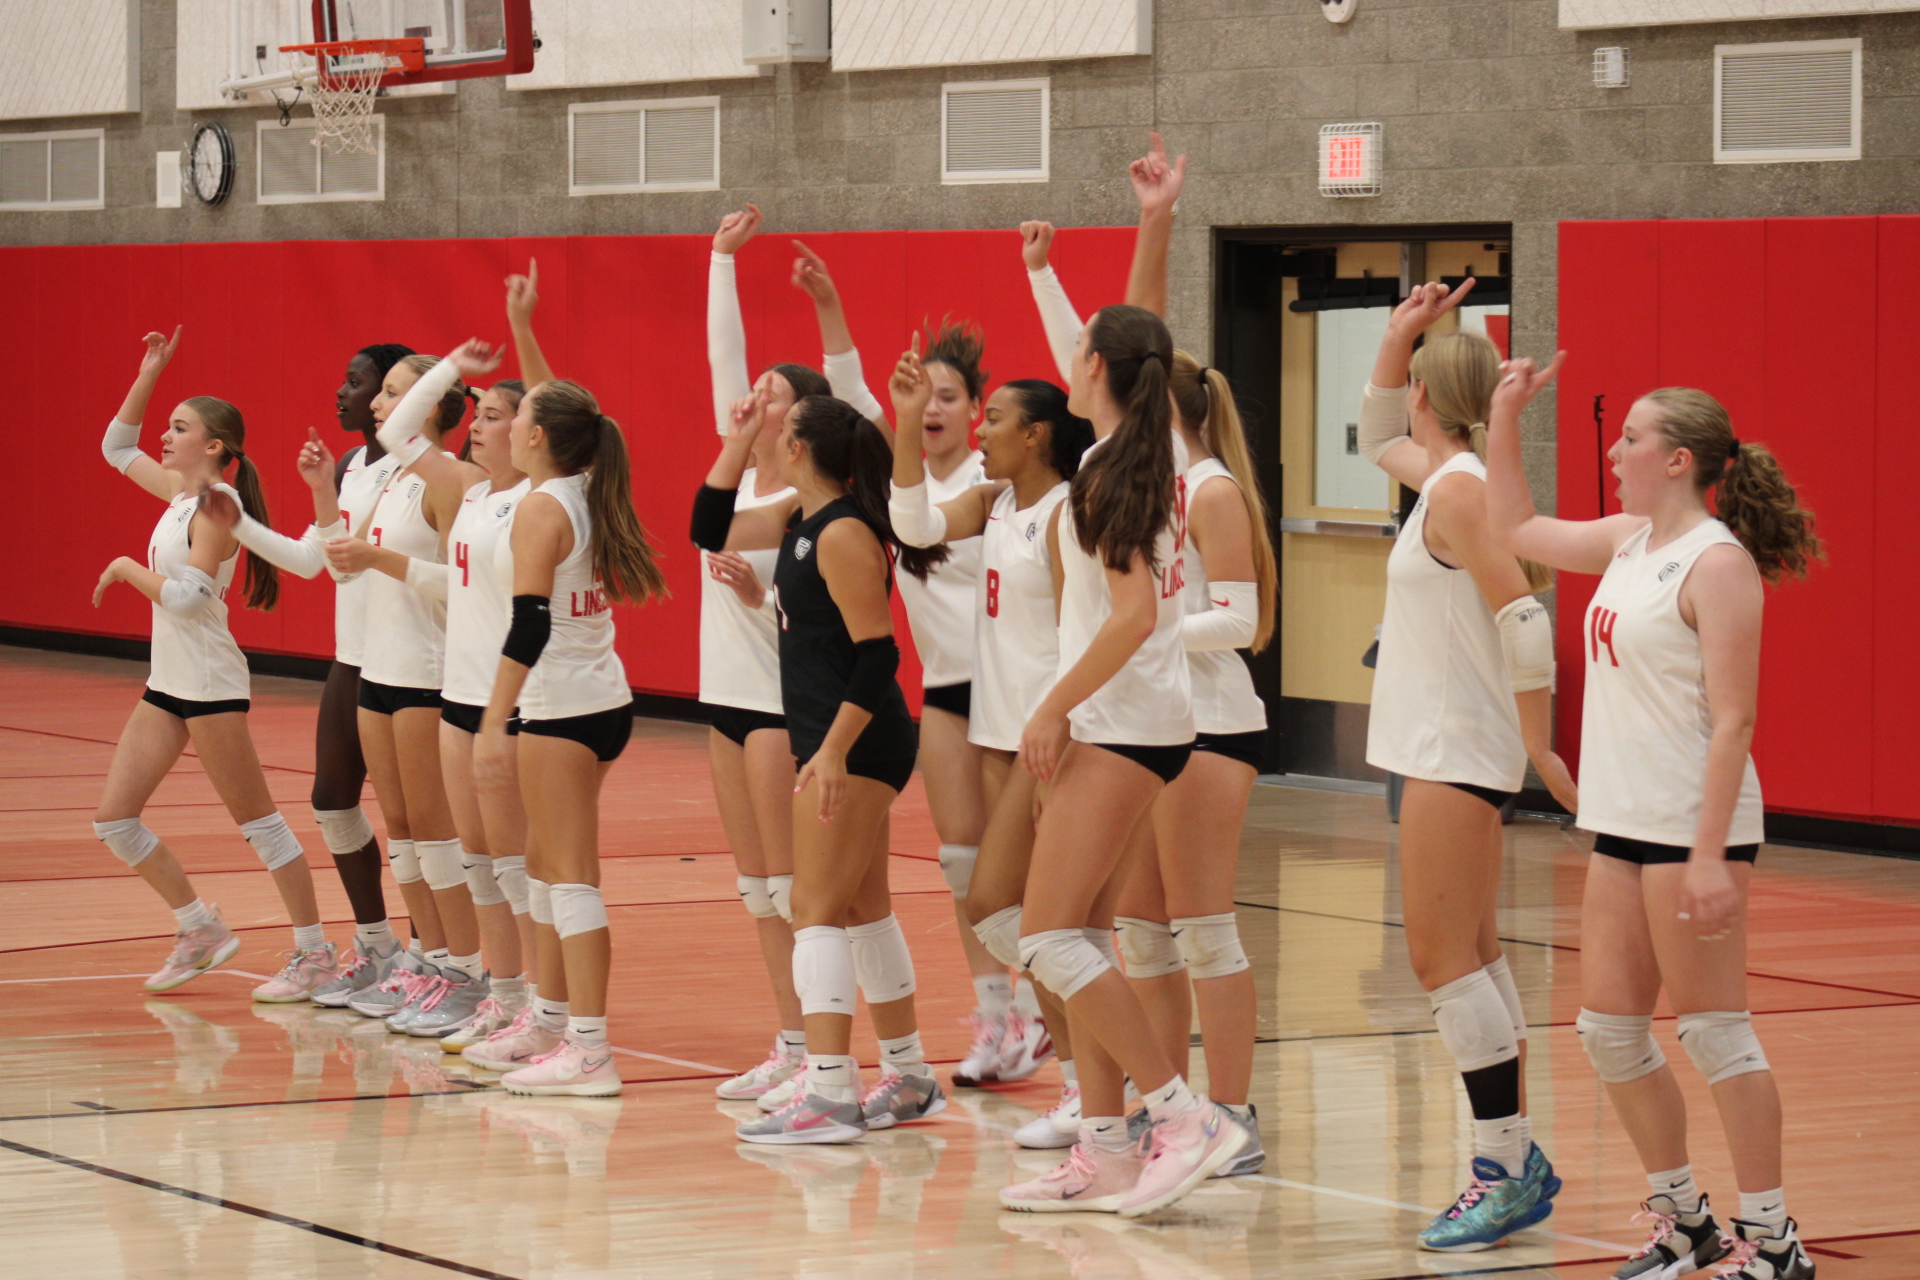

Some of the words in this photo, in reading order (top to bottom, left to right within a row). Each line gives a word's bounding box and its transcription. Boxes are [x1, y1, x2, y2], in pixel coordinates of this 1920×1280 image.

[1328, 137, 1363, 178] EXIT
[455, 541, 469, 587] 4
[986, 567, 1000, 618] 8
[1591, 605, 1619, 667] 14
